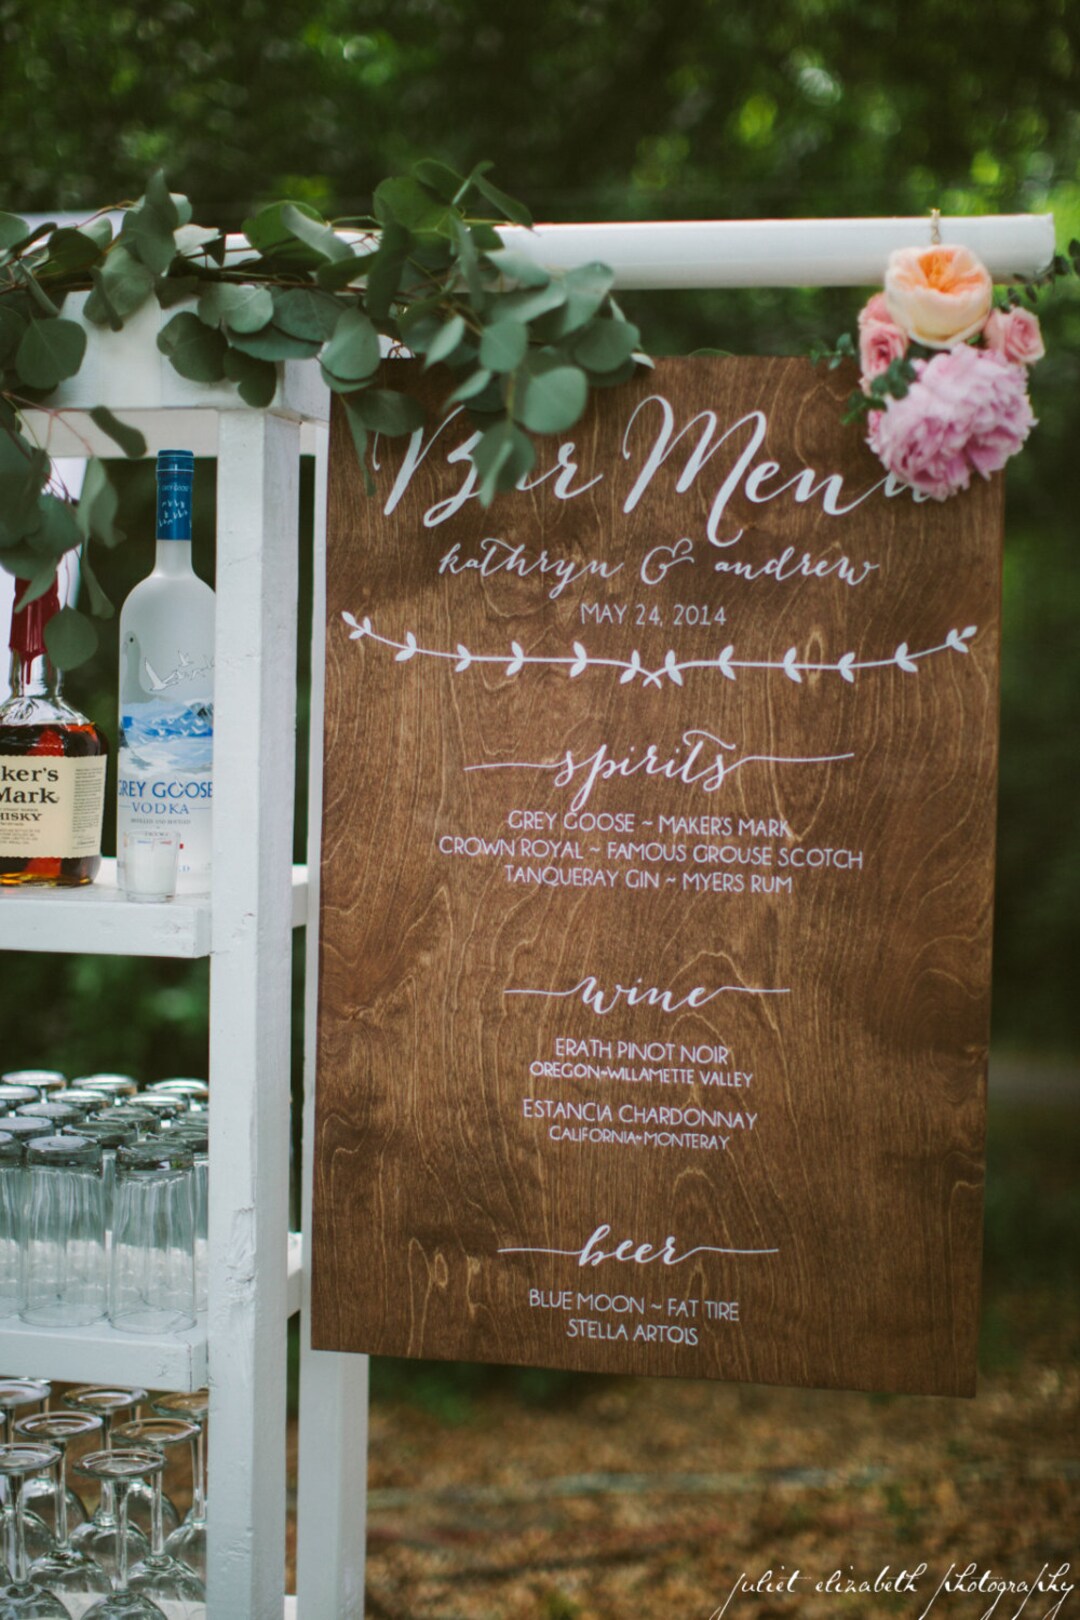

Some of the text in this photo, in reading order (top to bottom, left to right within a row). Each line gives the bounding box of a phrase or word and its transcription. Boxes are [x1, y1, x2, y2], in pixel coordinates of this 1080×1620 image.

[372, 405, 604, 528] Br
[438, 537, 880, 600] kathryn & andrew
[580, 603, 727, 628] MAY 24, 2014
[546, 729, 748, 811] spirits
[151, 780, 213, 798] GOOSE
[132, 802, 190, 815] VODKA
[507, 810, 558, 830] GREY
[563, 810, 635, 833] GOOSE
[658, 815, 733, 836] MAKER'S
[738, 819, 794, 838] MARK
[439, 835, 516, 857] CROWN
[520, 838, 584, 860] ROYAL
[607, 841, 687, 863] FAMOUS
[692, 844, 773, 866] GROUSE
[777, 848, 864, 870] SCOTCH
[504, 864, 619, 887] TANQUERAY
[625, 869, 660, 889] GIN
[682, 871, 745, 893] MYERS
[751, 874, 793, 894] RUM
[578, 976, 713, 1015] wine
[555, 1037, 730, 1065] ERATH PINOT NOIR
[699, 1070, 754, 1088] VALLEY
[522, 1098, 759, 1130] ESTANCIA CHARDONNAY
[577, 1224, 690, 1267] beer
[529, 1288, 573, 1310] BLUE
[576, 1293, 645, 1315] MOON
[667, 1297, 699, 1317] FAT
[704, 1300, 741, 1321] TIRE
[566, 1318, 700, 1346] STELLA ARTOIS
